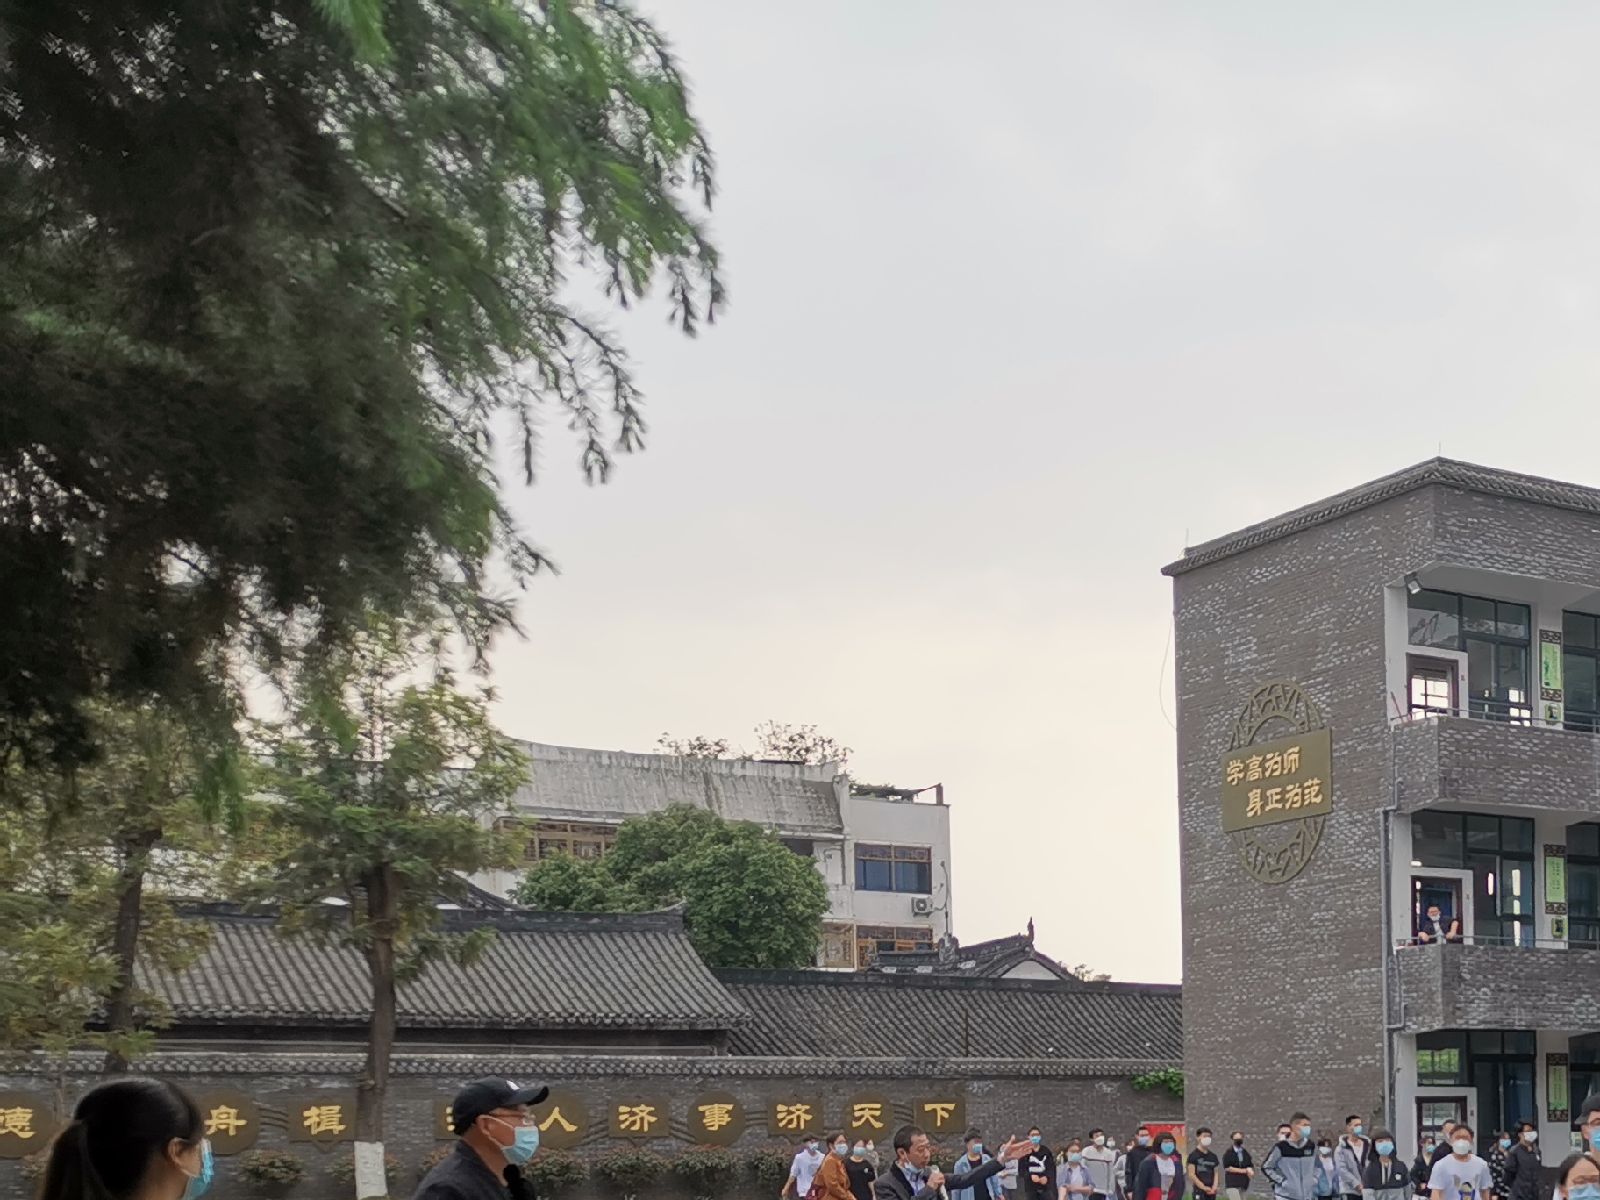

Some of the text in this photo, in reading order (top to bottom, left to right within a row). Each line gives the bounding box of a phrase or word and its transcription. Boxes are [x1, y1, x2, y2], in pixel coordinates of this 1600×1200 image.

[1226, 746, 1301, 786] 学高为师
[1246, 778, 1323, 817] 身正为范
